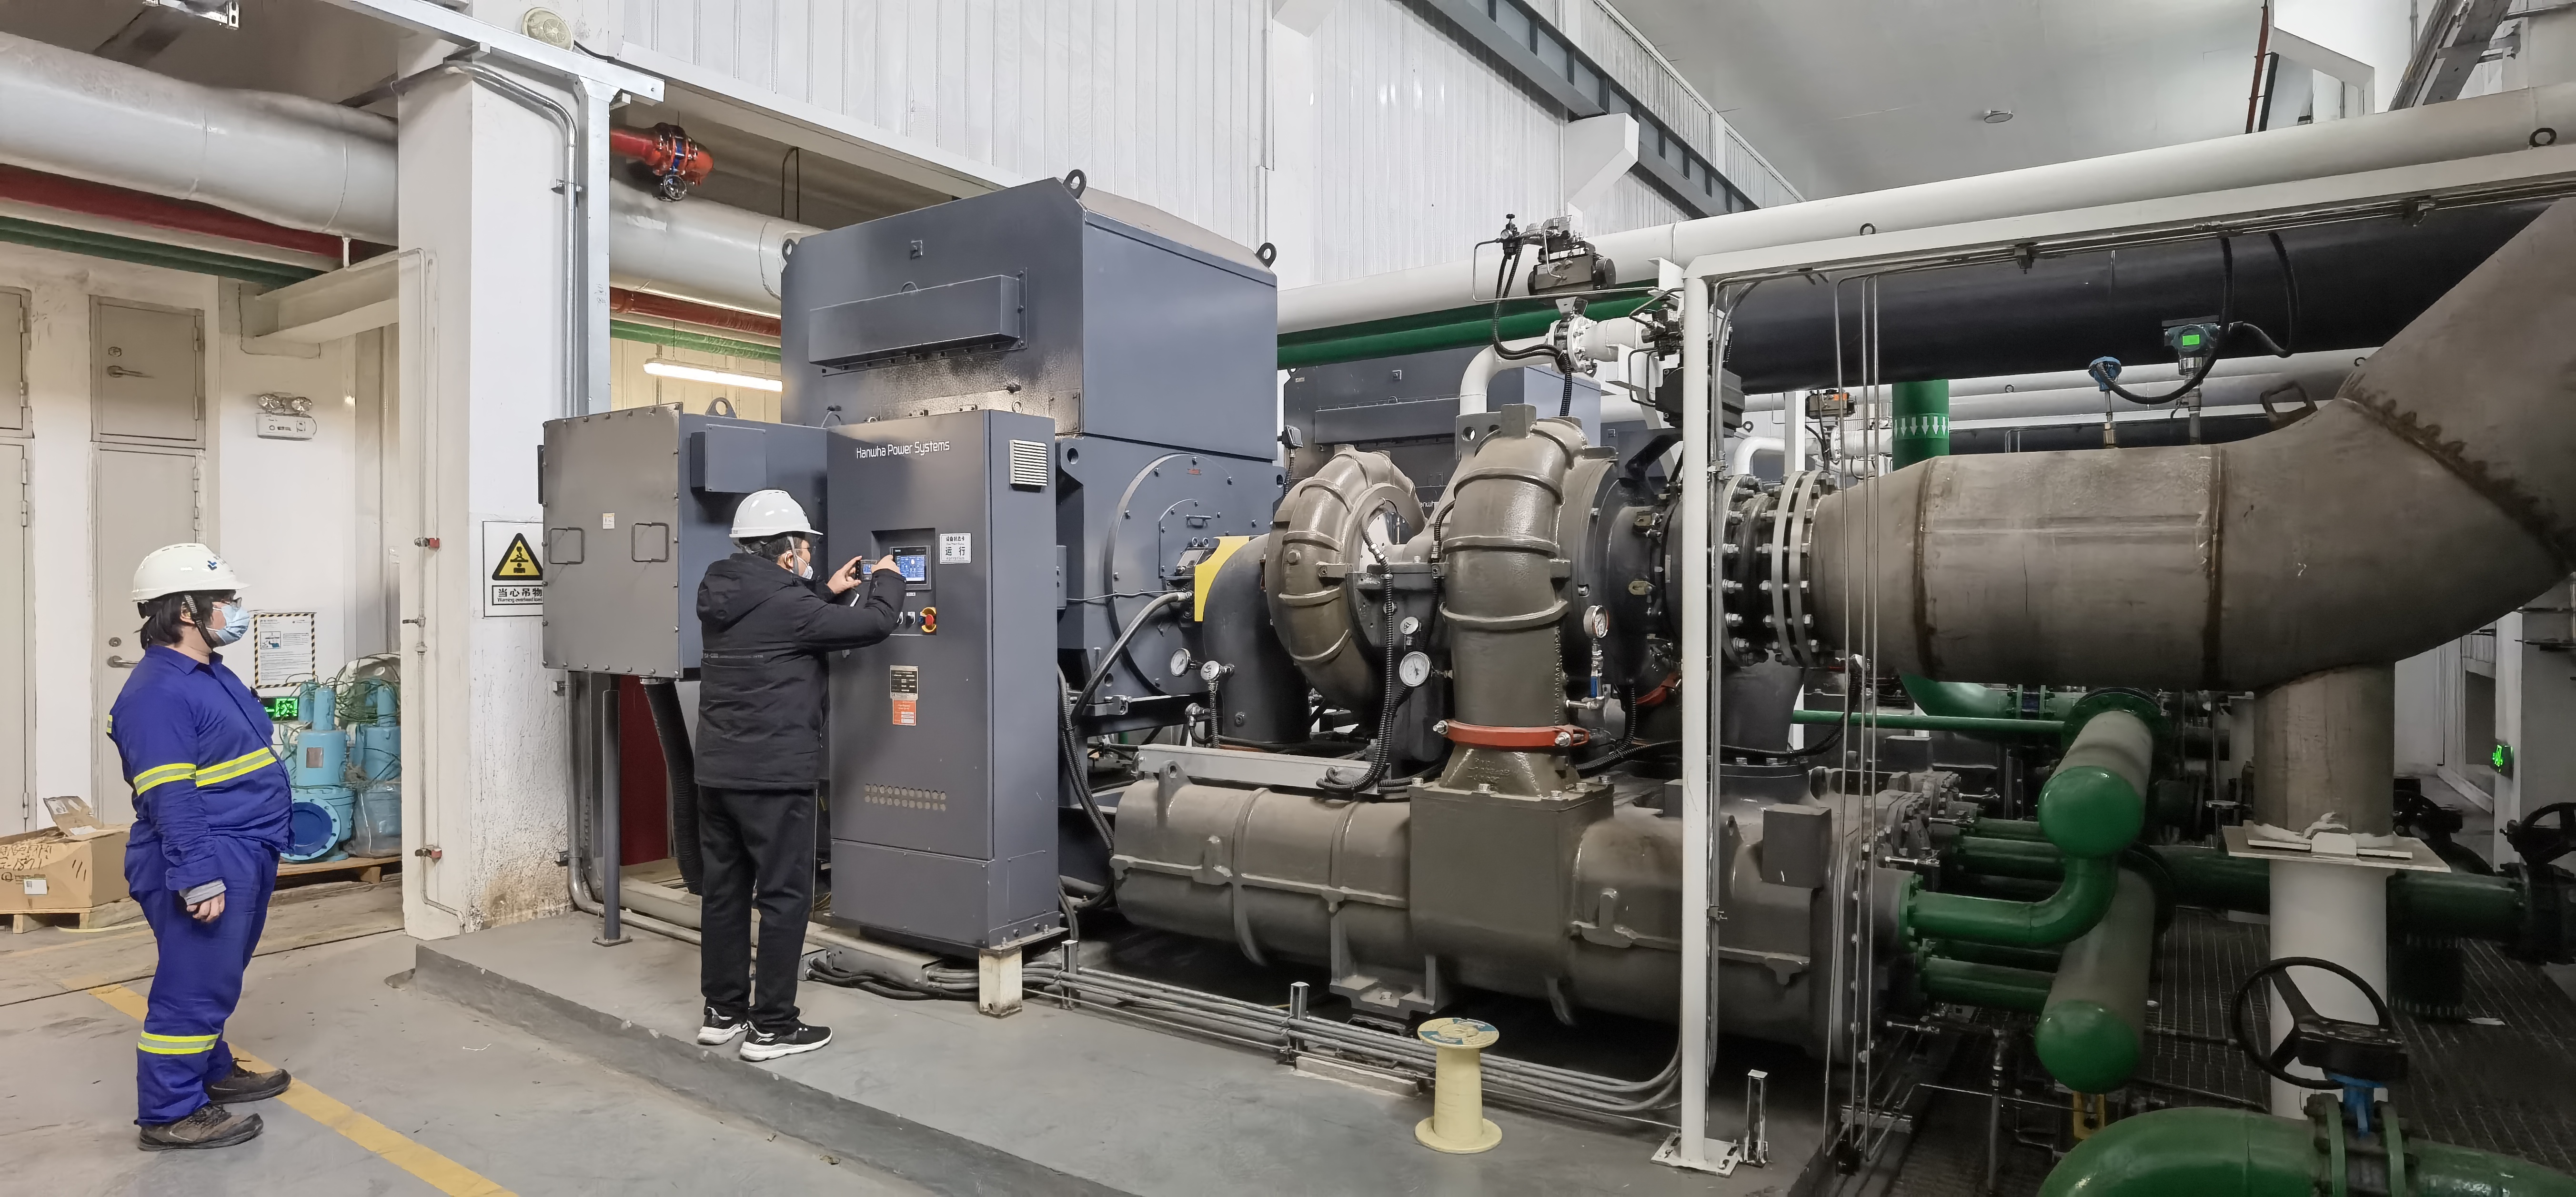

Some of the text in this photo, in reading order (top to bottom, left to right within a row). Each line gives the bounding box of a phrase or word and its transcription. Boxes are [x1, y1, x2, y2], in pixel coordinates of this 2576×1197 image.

[856, 441, 950, 459] Hanwha Power Systems
[946, 547, 965, 556] 运行
[498, 588, 542, 597] 当心吊物
